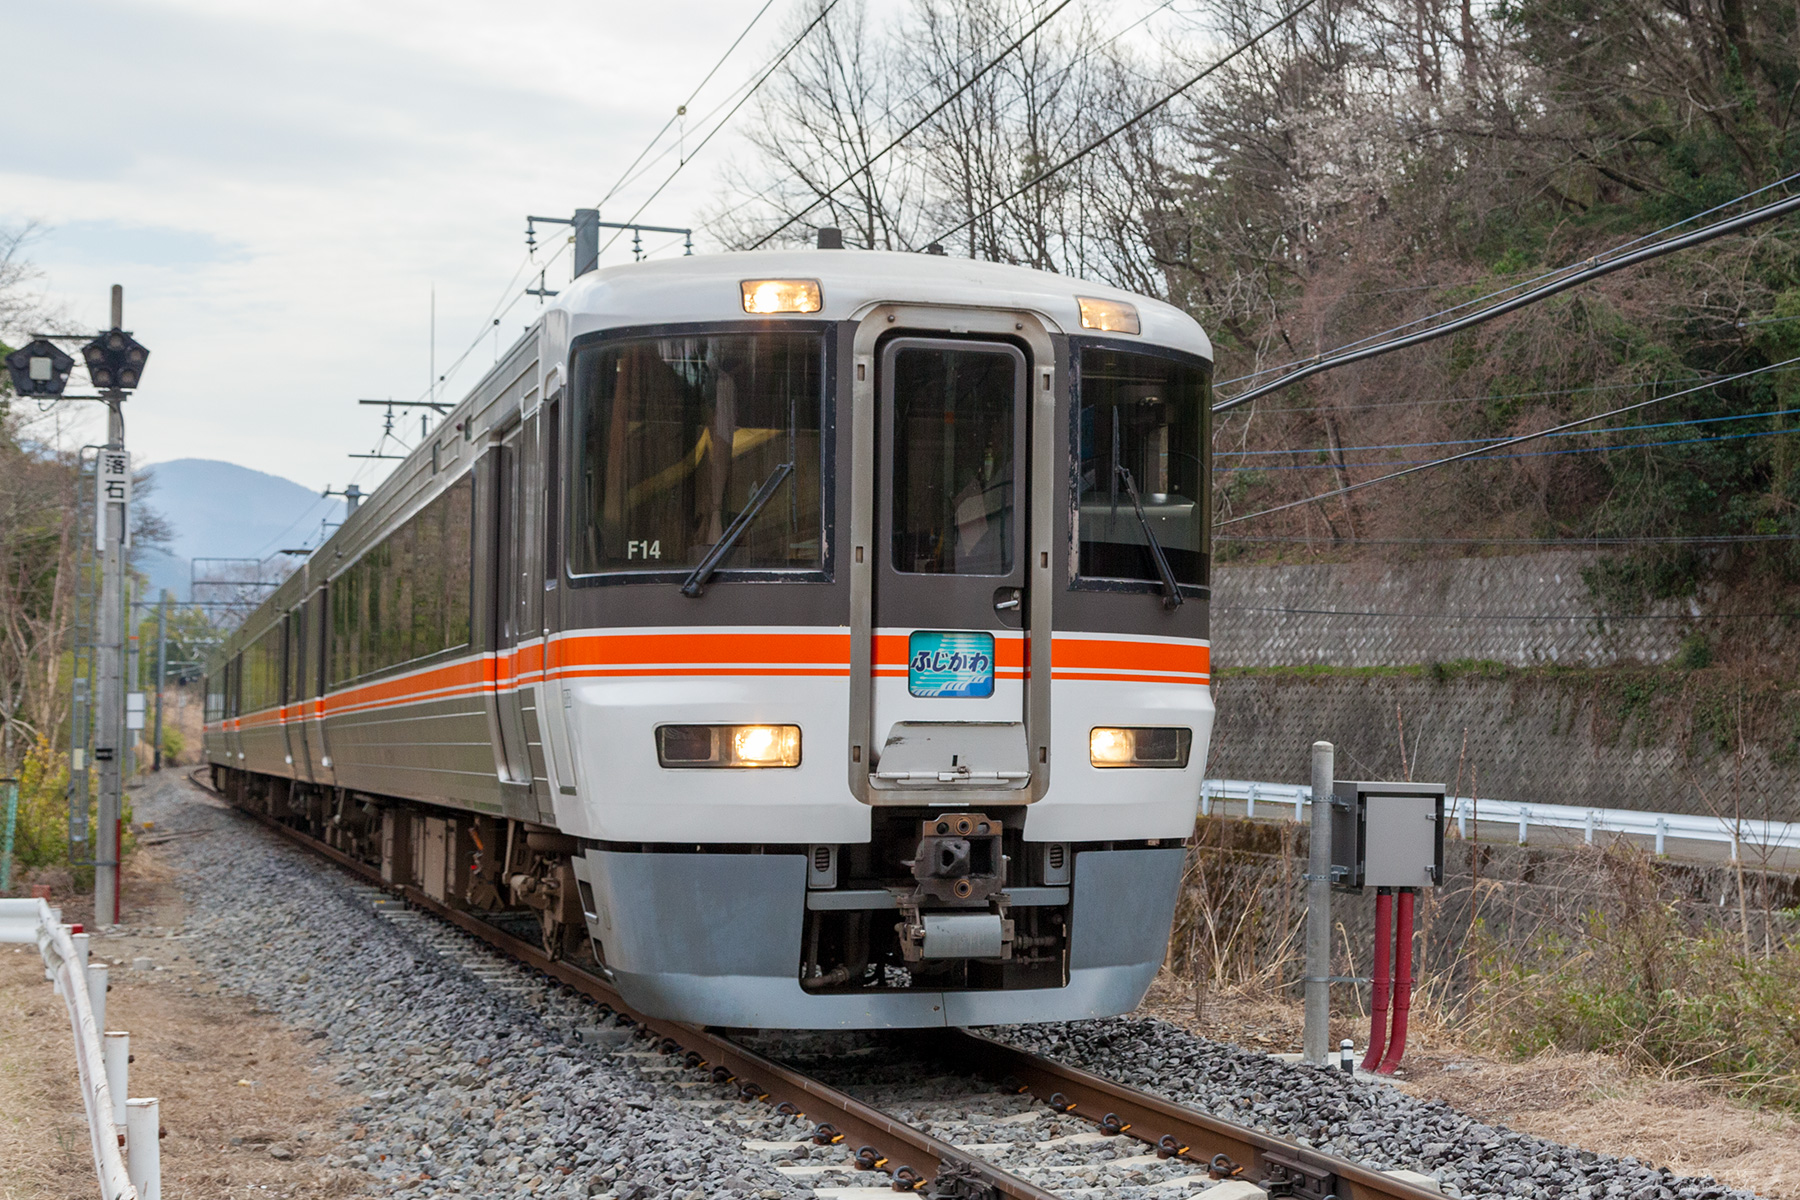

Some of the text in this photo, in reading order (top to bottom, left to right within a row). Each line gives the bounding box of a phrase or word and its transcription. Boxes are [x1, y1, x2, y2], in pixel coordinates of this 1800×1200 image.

[105, 454, 126, 499] 落石
[627, 540, 661, 560] F14
[910, 651, 989, 672] ふじかわ
